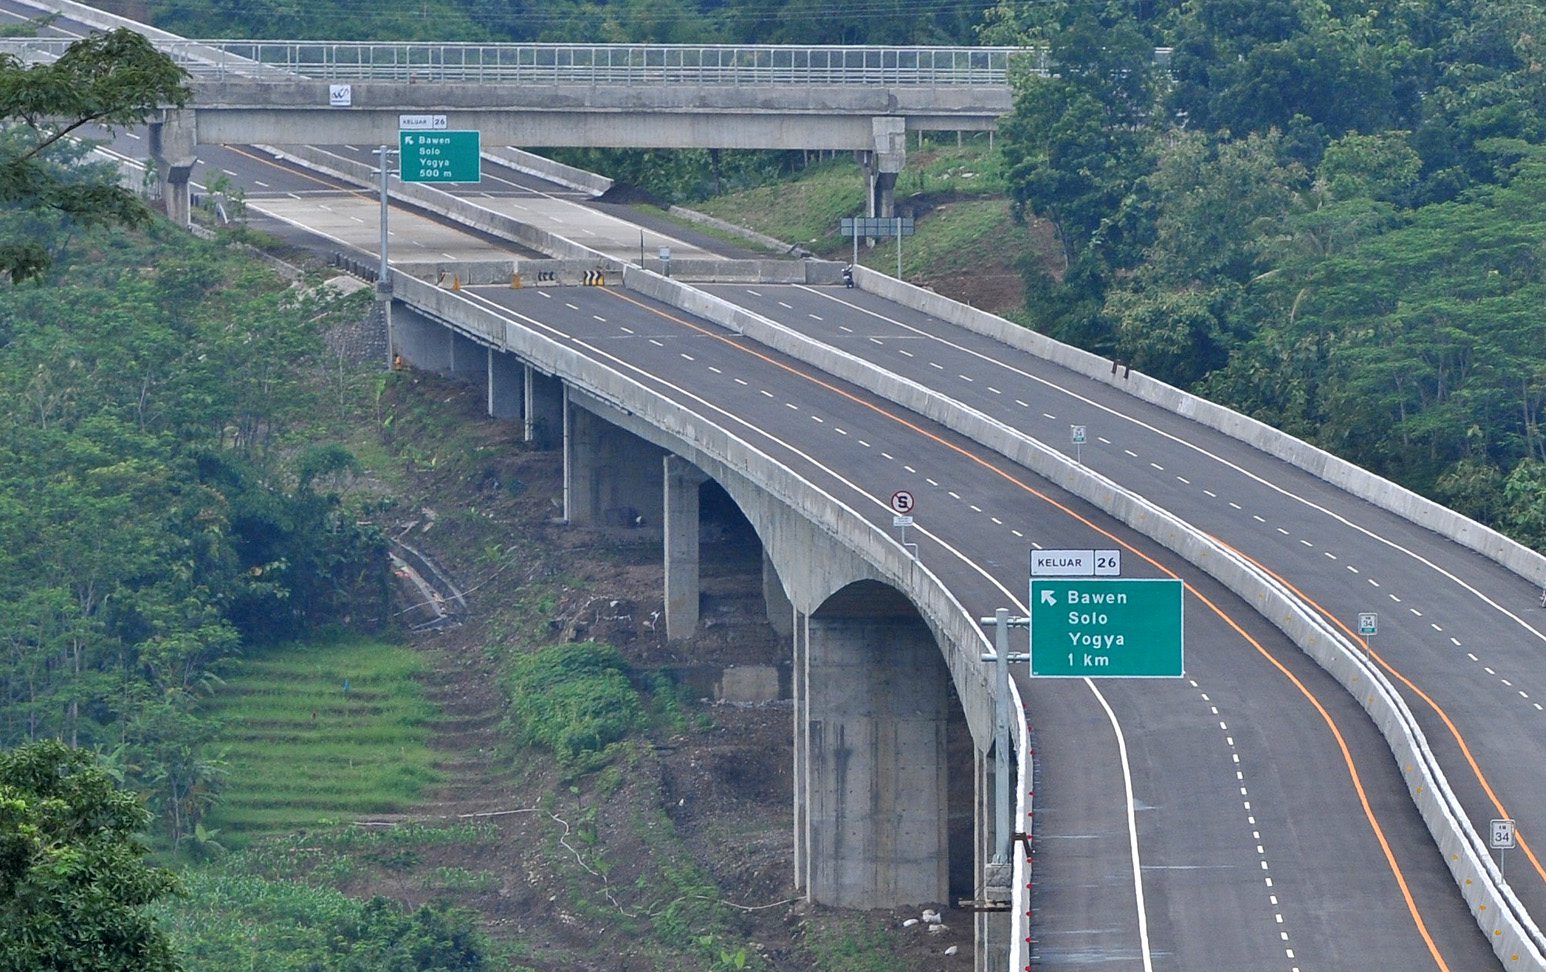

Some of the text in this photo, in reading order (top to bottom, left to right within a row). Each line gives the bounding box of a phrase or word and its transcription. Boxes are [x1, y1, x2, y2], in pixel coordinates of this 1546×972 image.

[419, 136, 450, 144] Bawen
[420, 158, 449, 168] Yogya
[420, 169, 439, 177] 500
[1038, 558, 1116, 568] KELUAR 26
[1068, 591, 1127, 604] Bawen
[1068, 612, 1108, 625] Solo
[1068, 632, 1125, 649] Yogya
[1068, 653, 1109, 666] 1 km
[1495, 832, 1509, 842] 34
